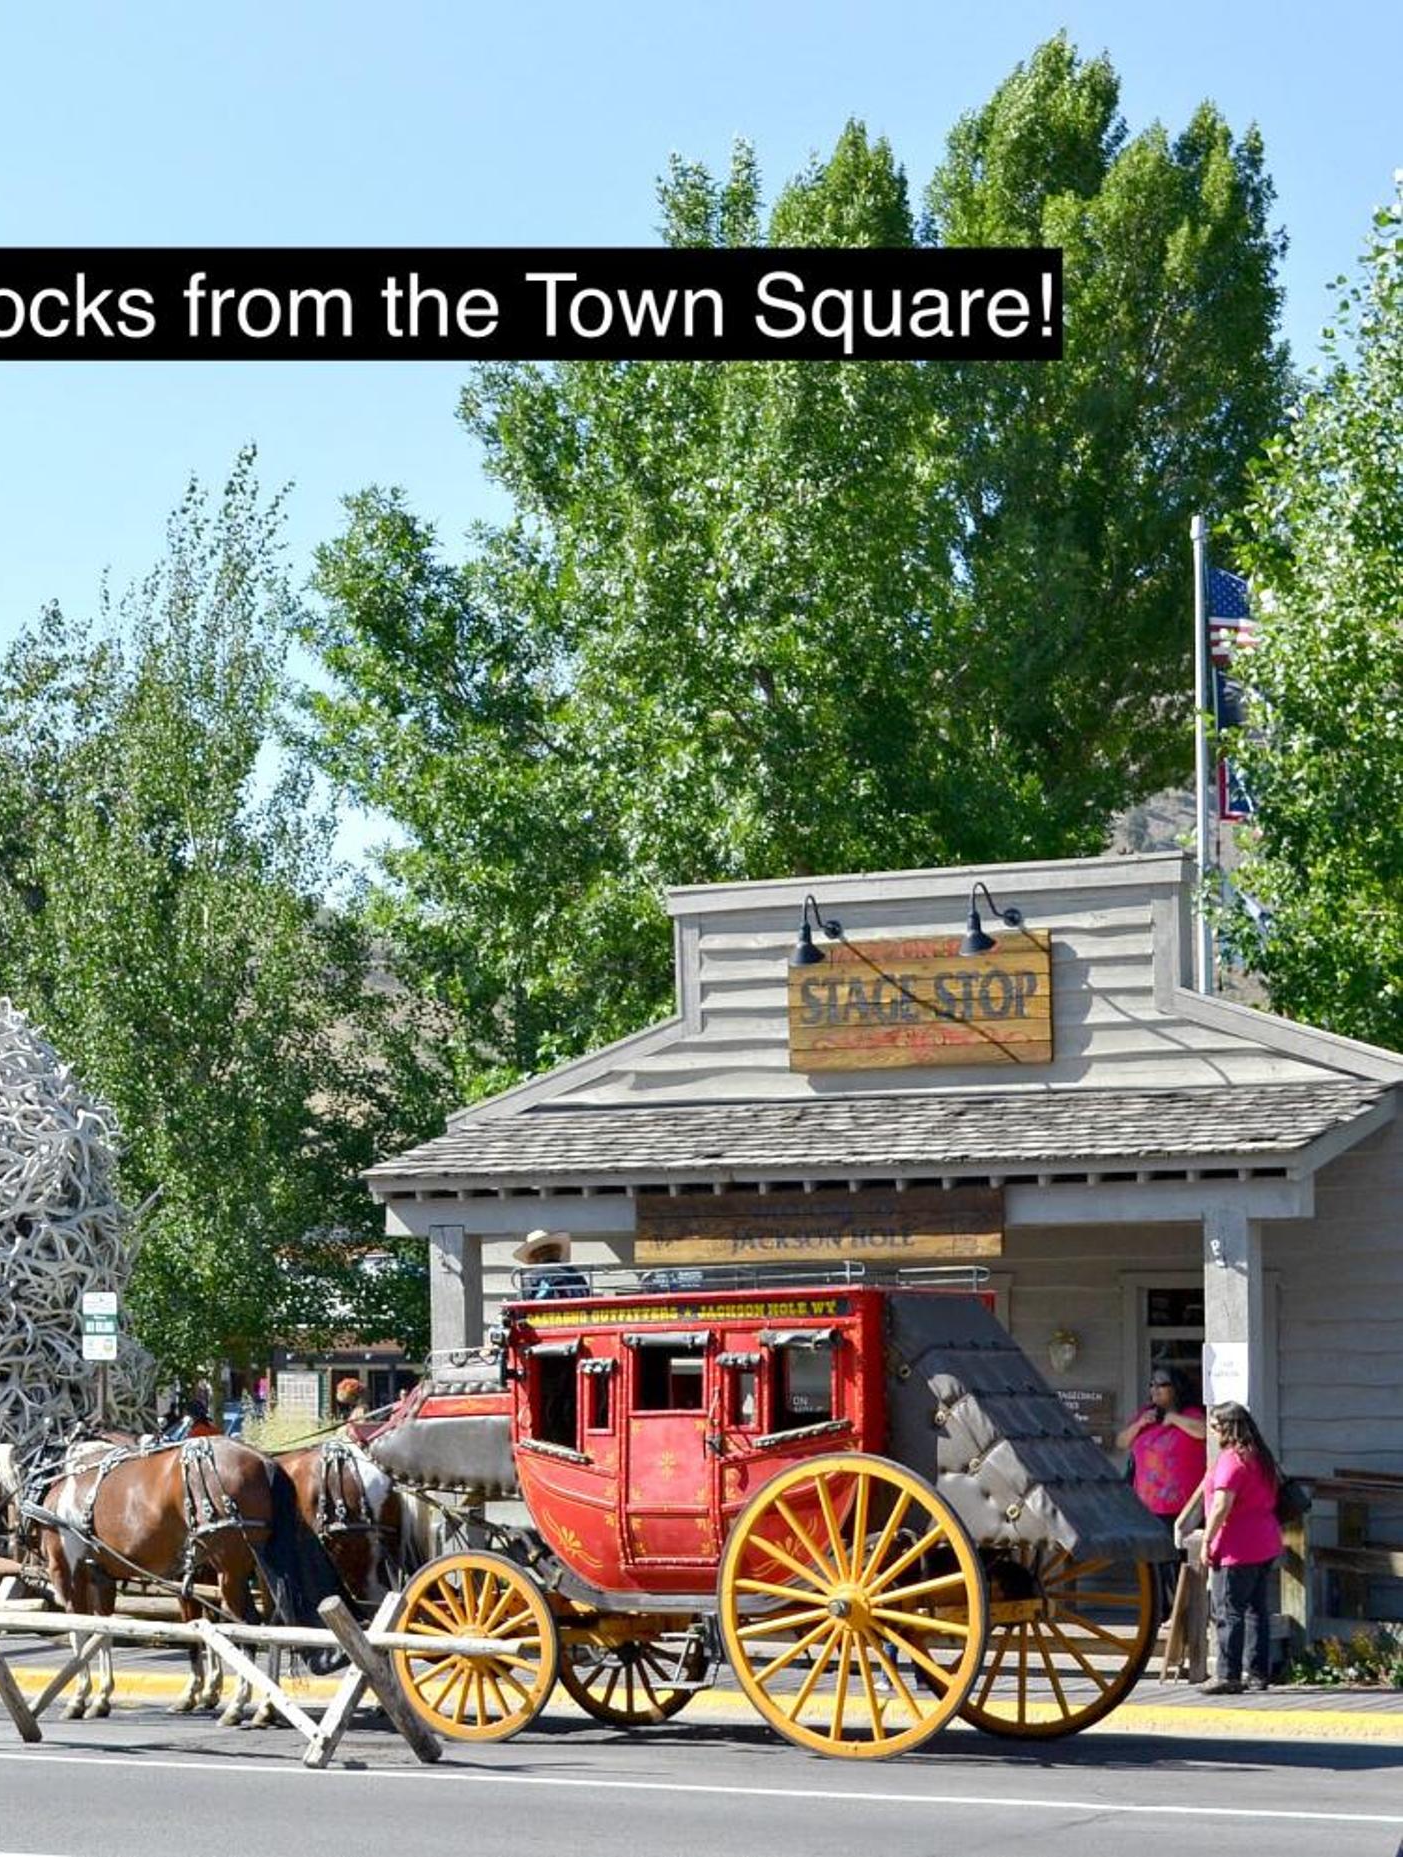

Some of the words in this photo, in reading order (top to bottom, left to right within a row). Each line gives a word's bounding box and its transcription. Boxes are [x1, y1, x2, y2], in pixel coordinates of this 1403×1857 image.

[800, 973, 920, 1026] STAGE
[934, 968, 1038, 1023] STOP
[732, 1227, 843, 1255] JACKSON
[851, 1224, 915, 1249] HOLE
[591, 1306, 679, 1323] OUTFITTERS
[697, 1302, 765, 1319] JACKSON
[767, 1300, 808, 1316] HOLE
[812, 1299, 838, 1315] WY
